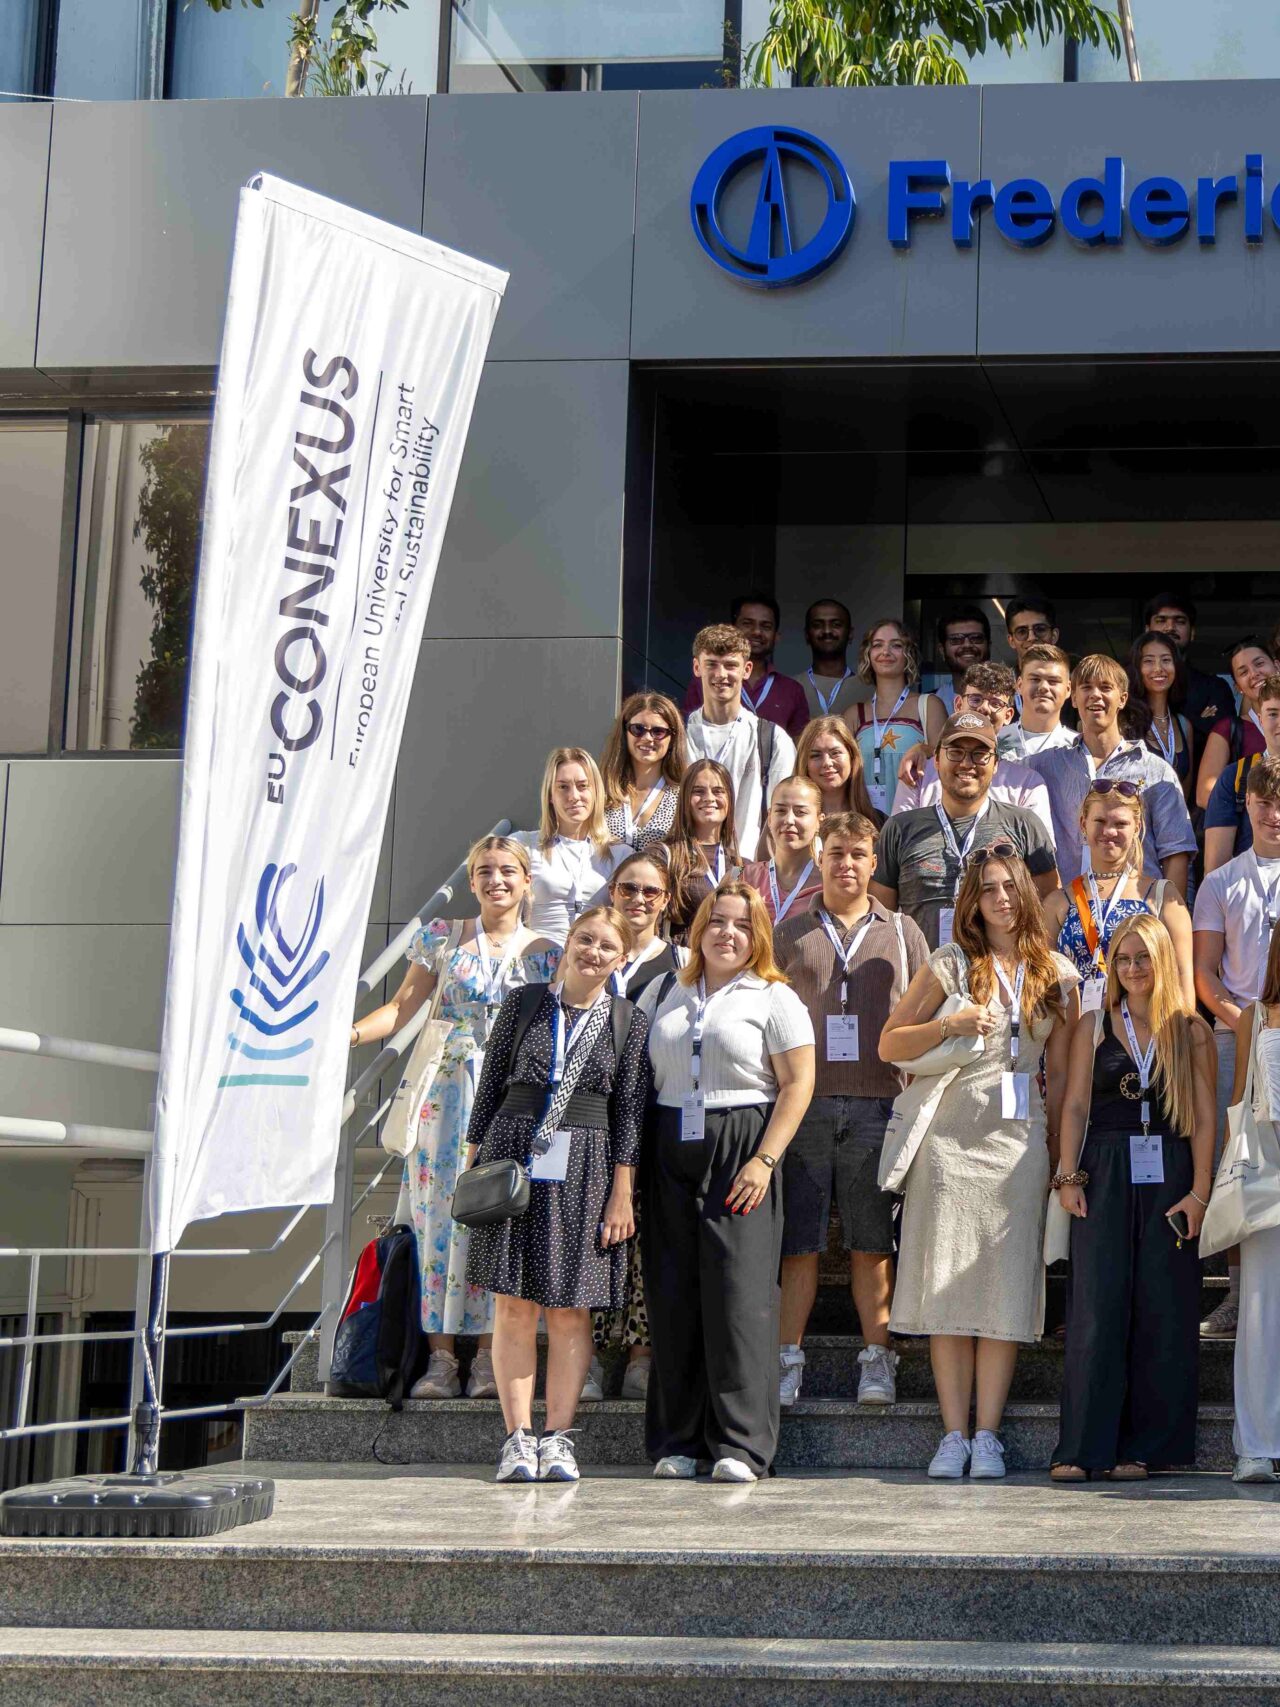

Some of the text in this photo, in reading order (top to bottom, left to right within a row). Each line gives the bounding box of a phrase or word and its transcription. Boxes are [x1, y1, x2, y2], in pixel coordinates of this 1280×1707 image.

[389, 382, 415, 460] Smart
[383, 465, 404, 502] for
[398, 416, 440, 584] Sustainability
[363, 508, 399, 637] University
